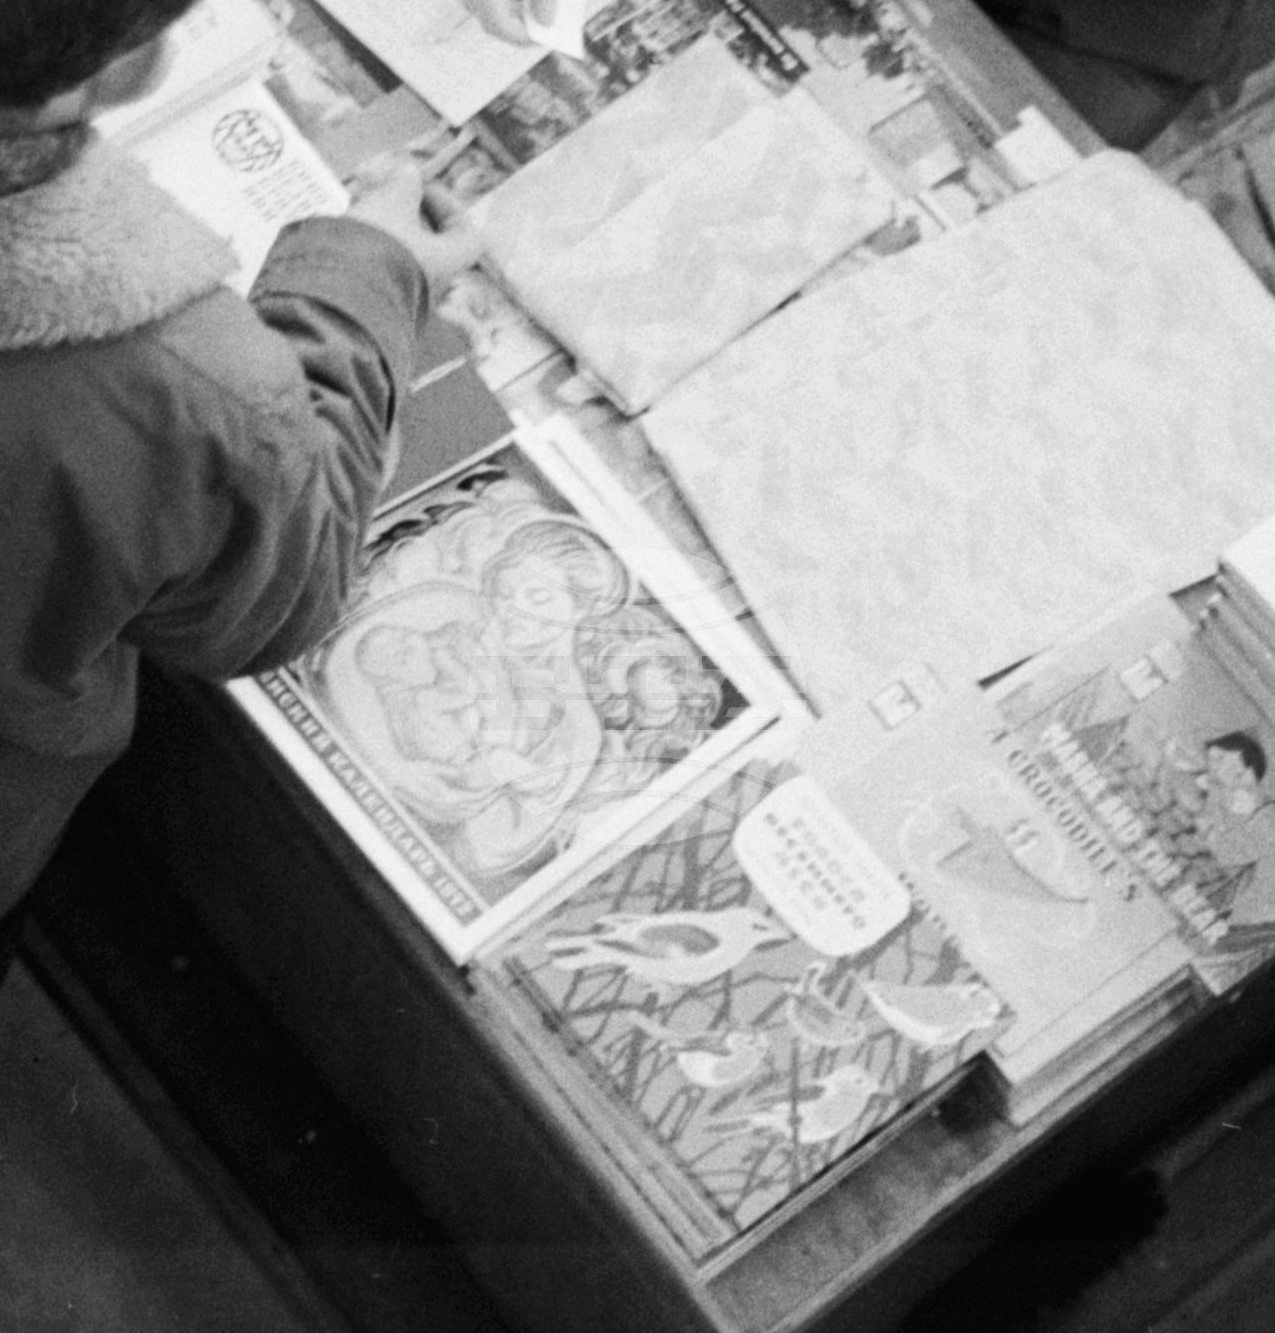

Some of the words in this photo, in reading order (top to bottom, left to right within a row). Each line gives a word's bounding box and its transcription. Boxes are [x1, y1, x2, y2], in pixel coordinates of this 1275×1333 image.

[1039, 721, 1109, 801] MASHA
[1095, 795, 1143, 846] AND
[1134, 838, 1183, 889] THE
